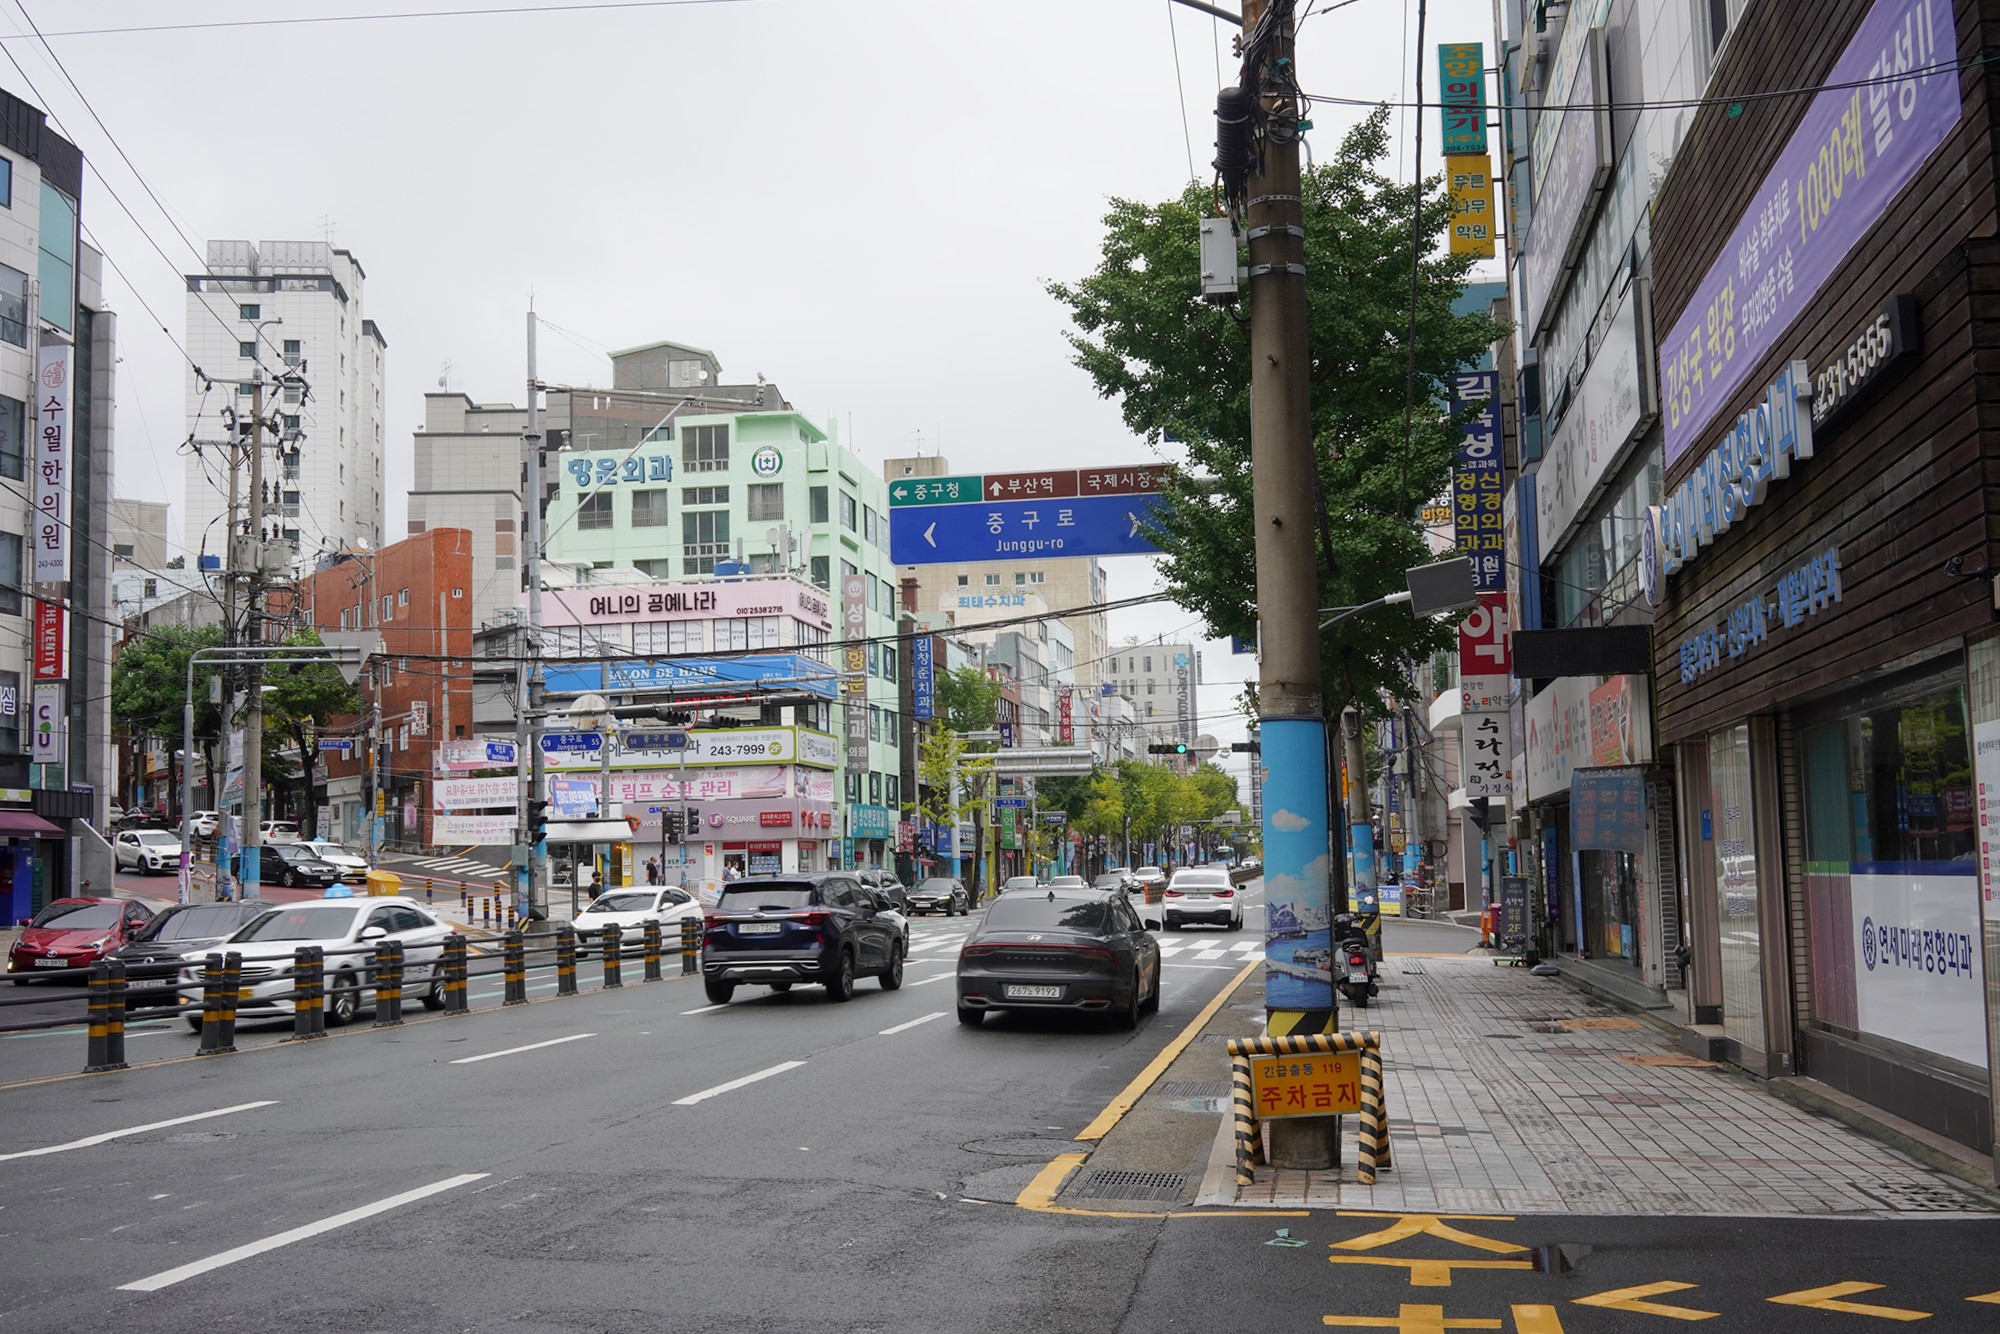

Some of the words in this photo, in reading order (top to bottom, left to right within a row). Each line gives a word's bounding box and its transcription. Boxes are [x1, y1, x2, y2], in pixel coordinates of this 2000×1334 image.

[1445, 144, 1486, 152] 204-7534
[1798, 87, 1866, 246] 1000례
[1453, 173, 1485, 189] 푸른
[1456, 199, 1486, 214] 나무
[1760, 177, 1791, 256] 척추치료
[1456, 224, 1487, 240] 학원
[1742, 266, 1777, 348] 무지외반증
[1777, 243, 1795, 304] 수술
[1667, 324, 1703, 431] 김성국
[1706, 274, 1736, 381] 원장
[1817, 312, 1893, 414] 231-5555
[41, 395, 64, 550] 수월한의원
[1660, 359, 1814, 576] 연세미래정형외과
[914, 481, 960, 500] 중구청
[1007, 476, 1054, 494] 부산역
[1087, 472, 1151, 491] 국제시장
[1455, 472, 1481, 551] 정형외과
[1479, 471, 1504, 551] 신경외과
[986, 508, 1076, 534] 중구로
[995, 538, 1064, 553] Junggu-ro
[38, 559, 64, 569] 243-4300
[589, 593, 640, 616] 여니의
[647, 590, 717, 614] 공예나라
[958, 594, 1026, 608] 최태수치과
[1680, 626, 1720, 685] 통증의학과
[1776, 546, 1843, 629] 재활의학과
[45, 627, 57, 662] VENTI
[608, 667, 650, 681] SALON
[656, 667, 675, 678] DE
[679, 665, 717, 677] HANS
[916, 638, 931, 708] 김창준치과
[1462, 681, 1485, 691] 건강한
[543, 738, 552, 748] 59
[559, 734, 583, 743] 중구로
[591, 737, 600, 746] 55
[644, 734, 670, 743] 중구로
[1475, 717, 1504, 779] 수라정
[710, 743, 765, 756] 243-7999
[769, 744, 781, 753] 2F
[848, 745, 868, 758] 의원
[622, 783, 655, 799] 림프
[660, 782, 694, 799] 순환
[699, 780, 732, 797] 관리
[725, 815, 757, 823] SQUARE
[1508, 923, 1521, 933] 2F
[1879, 925, 1973, 979] 연세미래정형외과
[1034, 986, 1057, 997] 9192
[1263, 1063, 1314, 1079] 긴급출동
[1321, 1062, 1342, 1074] 119
[1261, 1081, 1357, 1111] 주차금지
